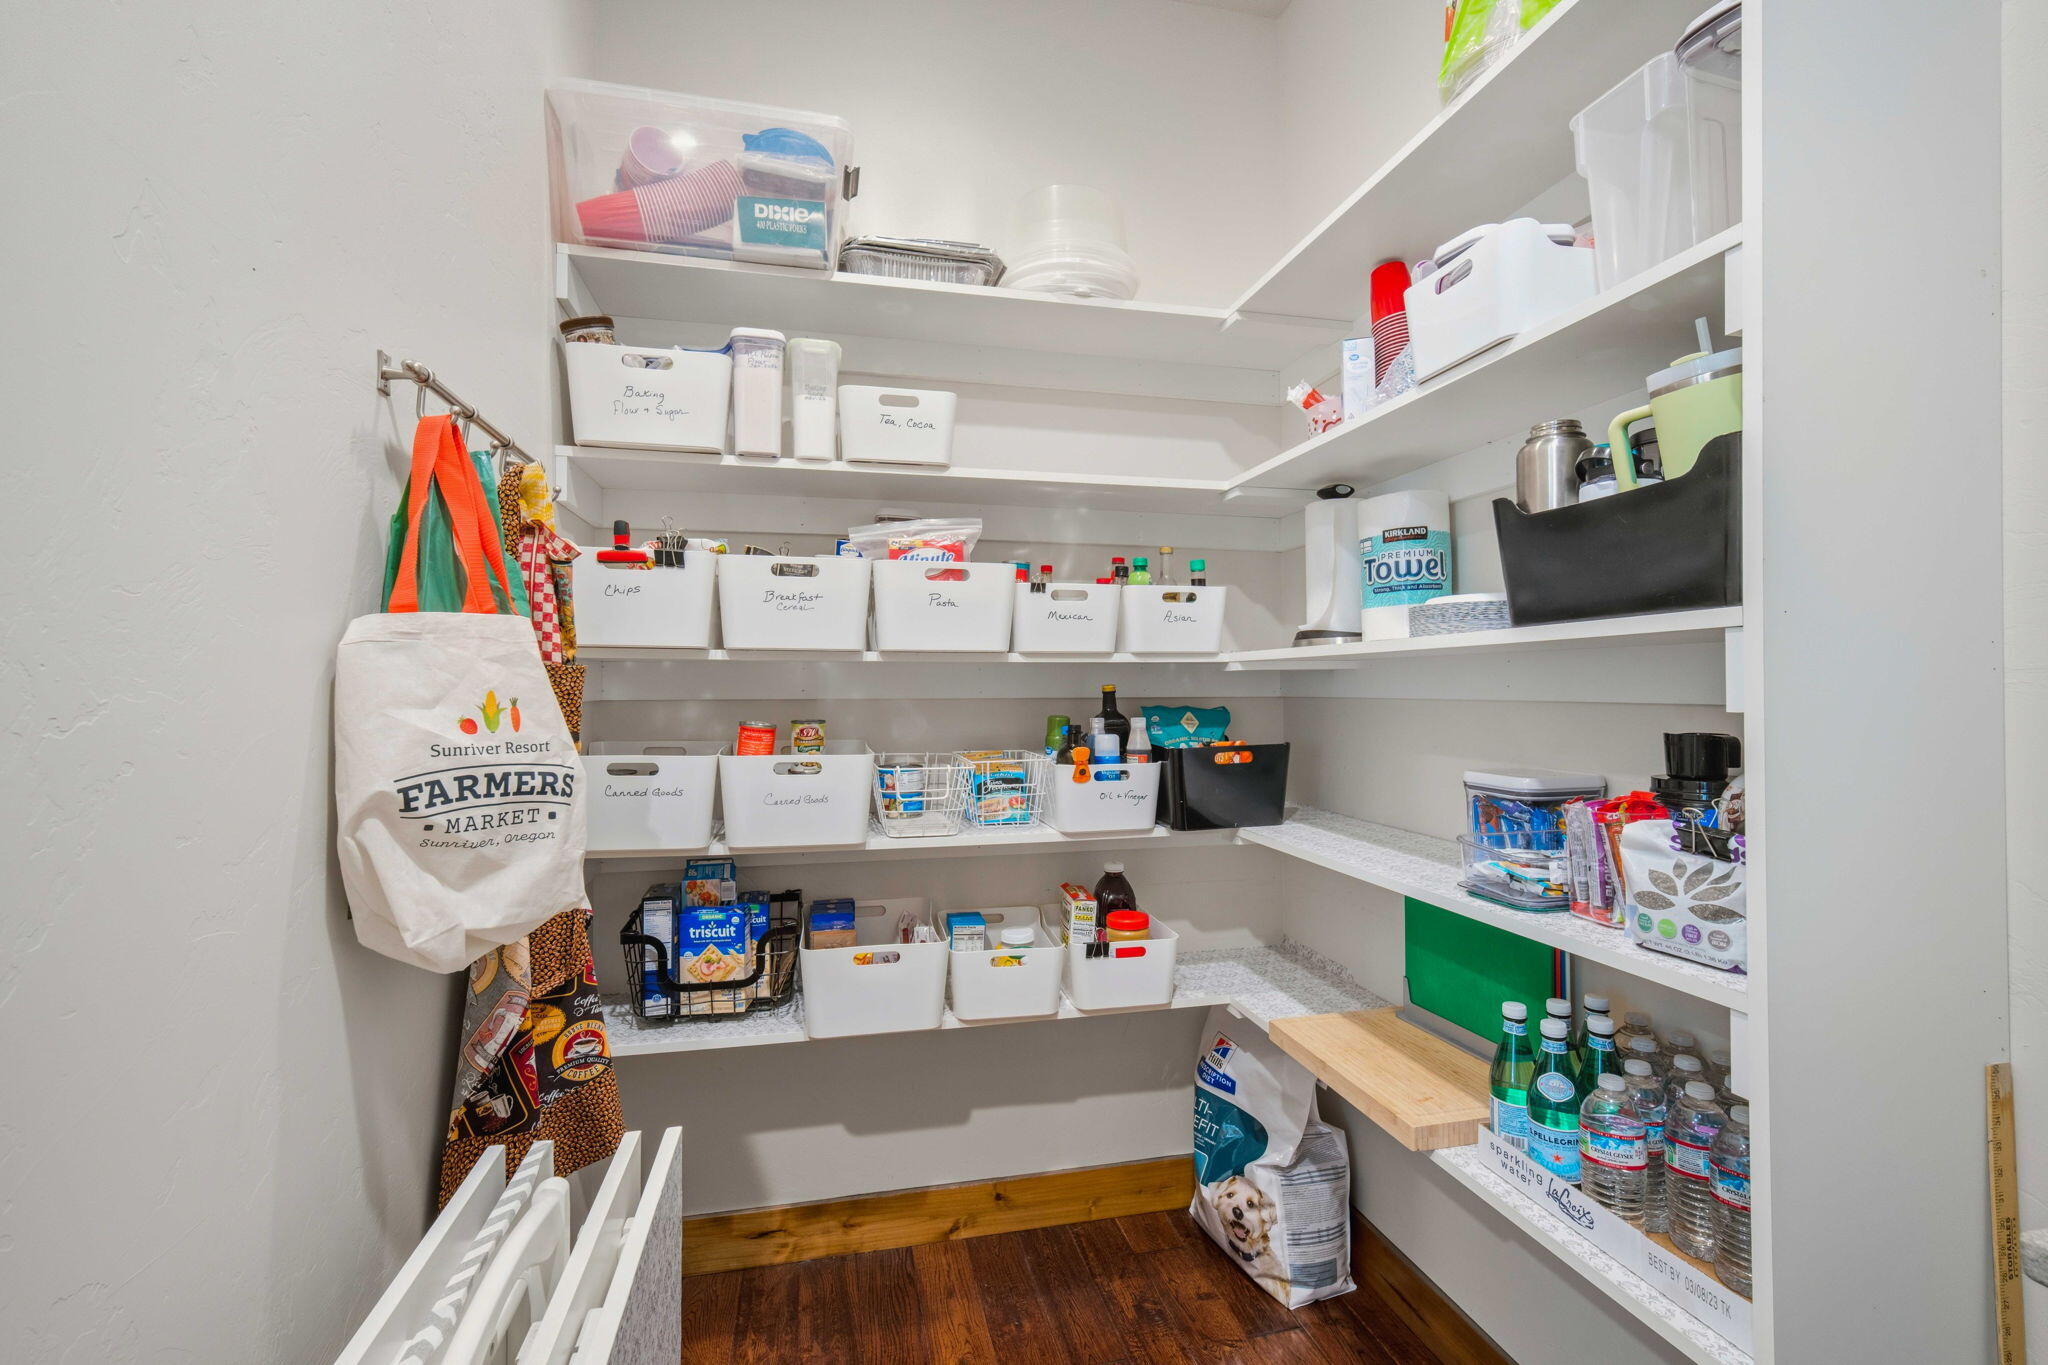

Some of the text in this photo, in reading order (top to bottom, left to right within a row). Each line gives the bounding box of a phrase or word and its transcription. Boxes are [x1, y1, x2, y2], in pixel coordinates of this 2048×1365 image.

[766, 221, 789, 232] PLASTIC
[624, 386, 665, 405] Baking
[656, 404, 690, 421] Sugar
[880, 414, 936, 430] Tea, Cocoa
[1385, 528, 1427, 538] KIRKLAND
[1381, 549, 1433, 560] PREMIUM
[1364, 551, 1447, 583] Towel
[604, 584, 641, 597] Chips
[763, 590, 824, 604] Breakfast
[776, 602, 815, 611] Cereal
[929, 593, 959, 608] Pasta
[1048, 611, 1094, 621] Mexican
[1163, 610, 1197, 623] Asian
[430, 741, 551, 758] Sunriver Resort
[397, 771, 575, 813] FARMERS
[604, 785, 684, 798] Canned Goods
[1124, 789, 1148, 806] Vinegar
[763, 793, 829, 807] Canned Goods
[444, 808, 541, 835] MARKET
[689, 922, 736, 939] triscuit
[556, 1056, 610, 1074] PREMIUM QUALITY
[566, 1065, 600, 1079] COFFEE
[1202, 1072, 1215, 1085] DIET
[1590, 1145, 1612, 1157] CRYSTAL
[1613, 1152, 1634, 1160] GEYSER
[1490, 1141, 1543, 1186] sparkling
[1501, 1159, 1532, 1187] water
[1721, 1186, 1749, 1200] CRYSTAL
[1546, 1177, 1595, 1230] LaCroix
[1648, 1251, 1668, 1276] BEST
[1669, 1265, 1681, 1284] BY
[1720, 1298, 1732, 1321] TK
